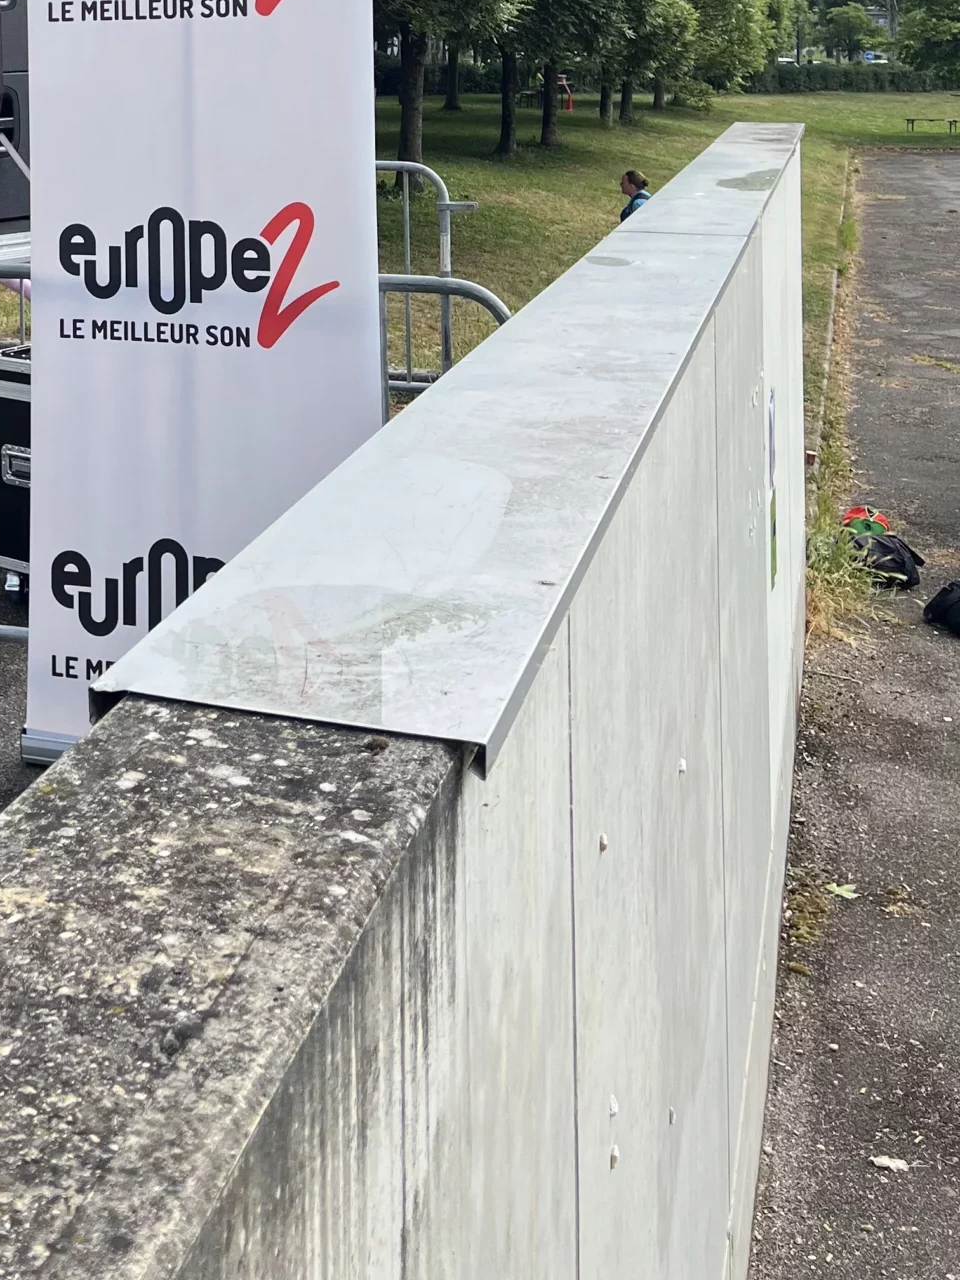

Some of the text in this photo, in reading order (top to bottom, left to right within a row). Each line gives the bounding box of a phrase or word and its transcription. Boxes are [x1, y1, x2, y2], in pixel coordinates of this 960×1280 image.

[48, 1, 75, 23] LE
[59, 318, 251, 348] LE MEILLEUR SON
[51, 654, 79, 680] LE
